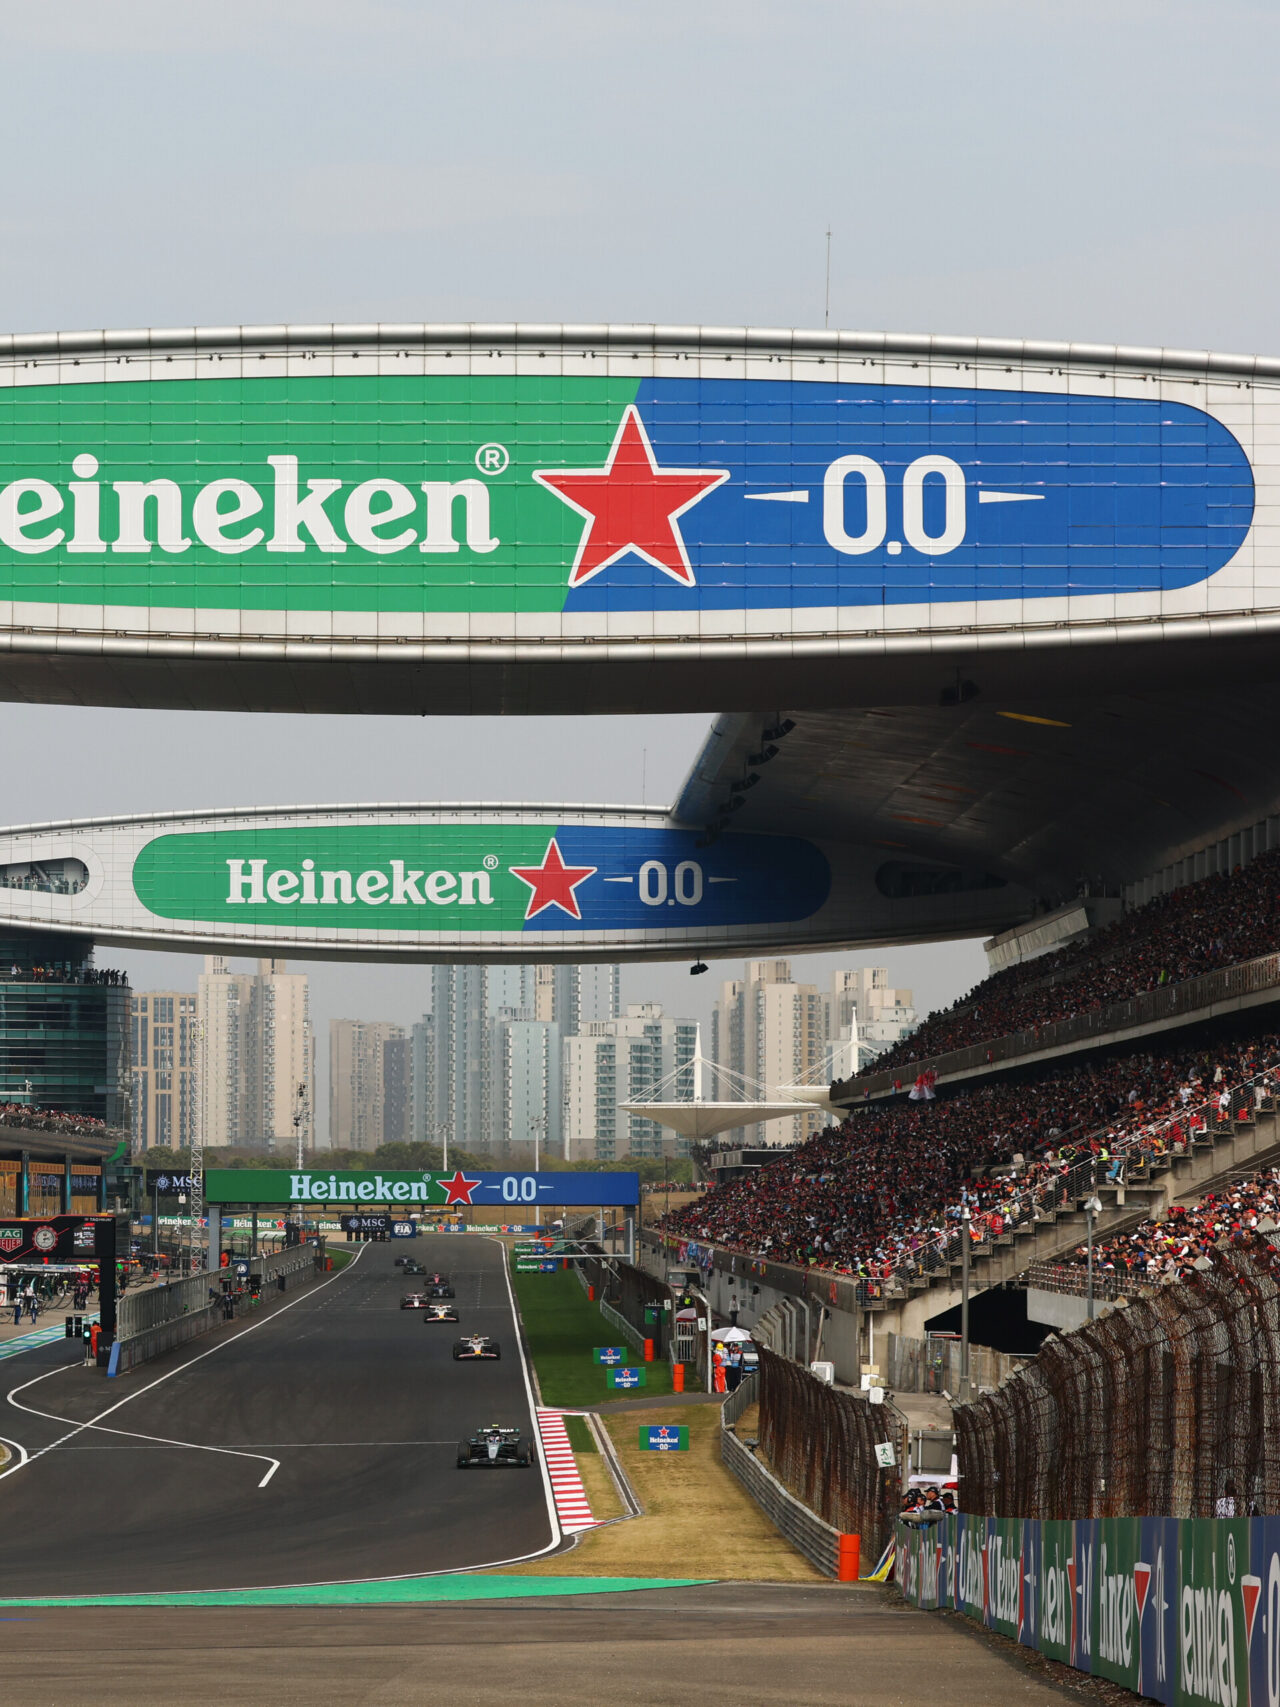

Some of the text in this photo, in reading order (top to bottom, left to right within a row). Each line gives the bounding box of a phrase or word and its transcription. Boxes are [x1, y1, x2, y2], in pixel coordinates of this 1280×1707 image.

[823, 454, 966, 555] 0.0
[225, 858, 704, 907] Heineken 0.0
[289, 1175, 537, 1201] Heineken 0.0
[233, 1218, 272, 1228] Heinken
[361, 1218, 386, 1227] MSC
[394, 1223, 412, 1235] FIA
